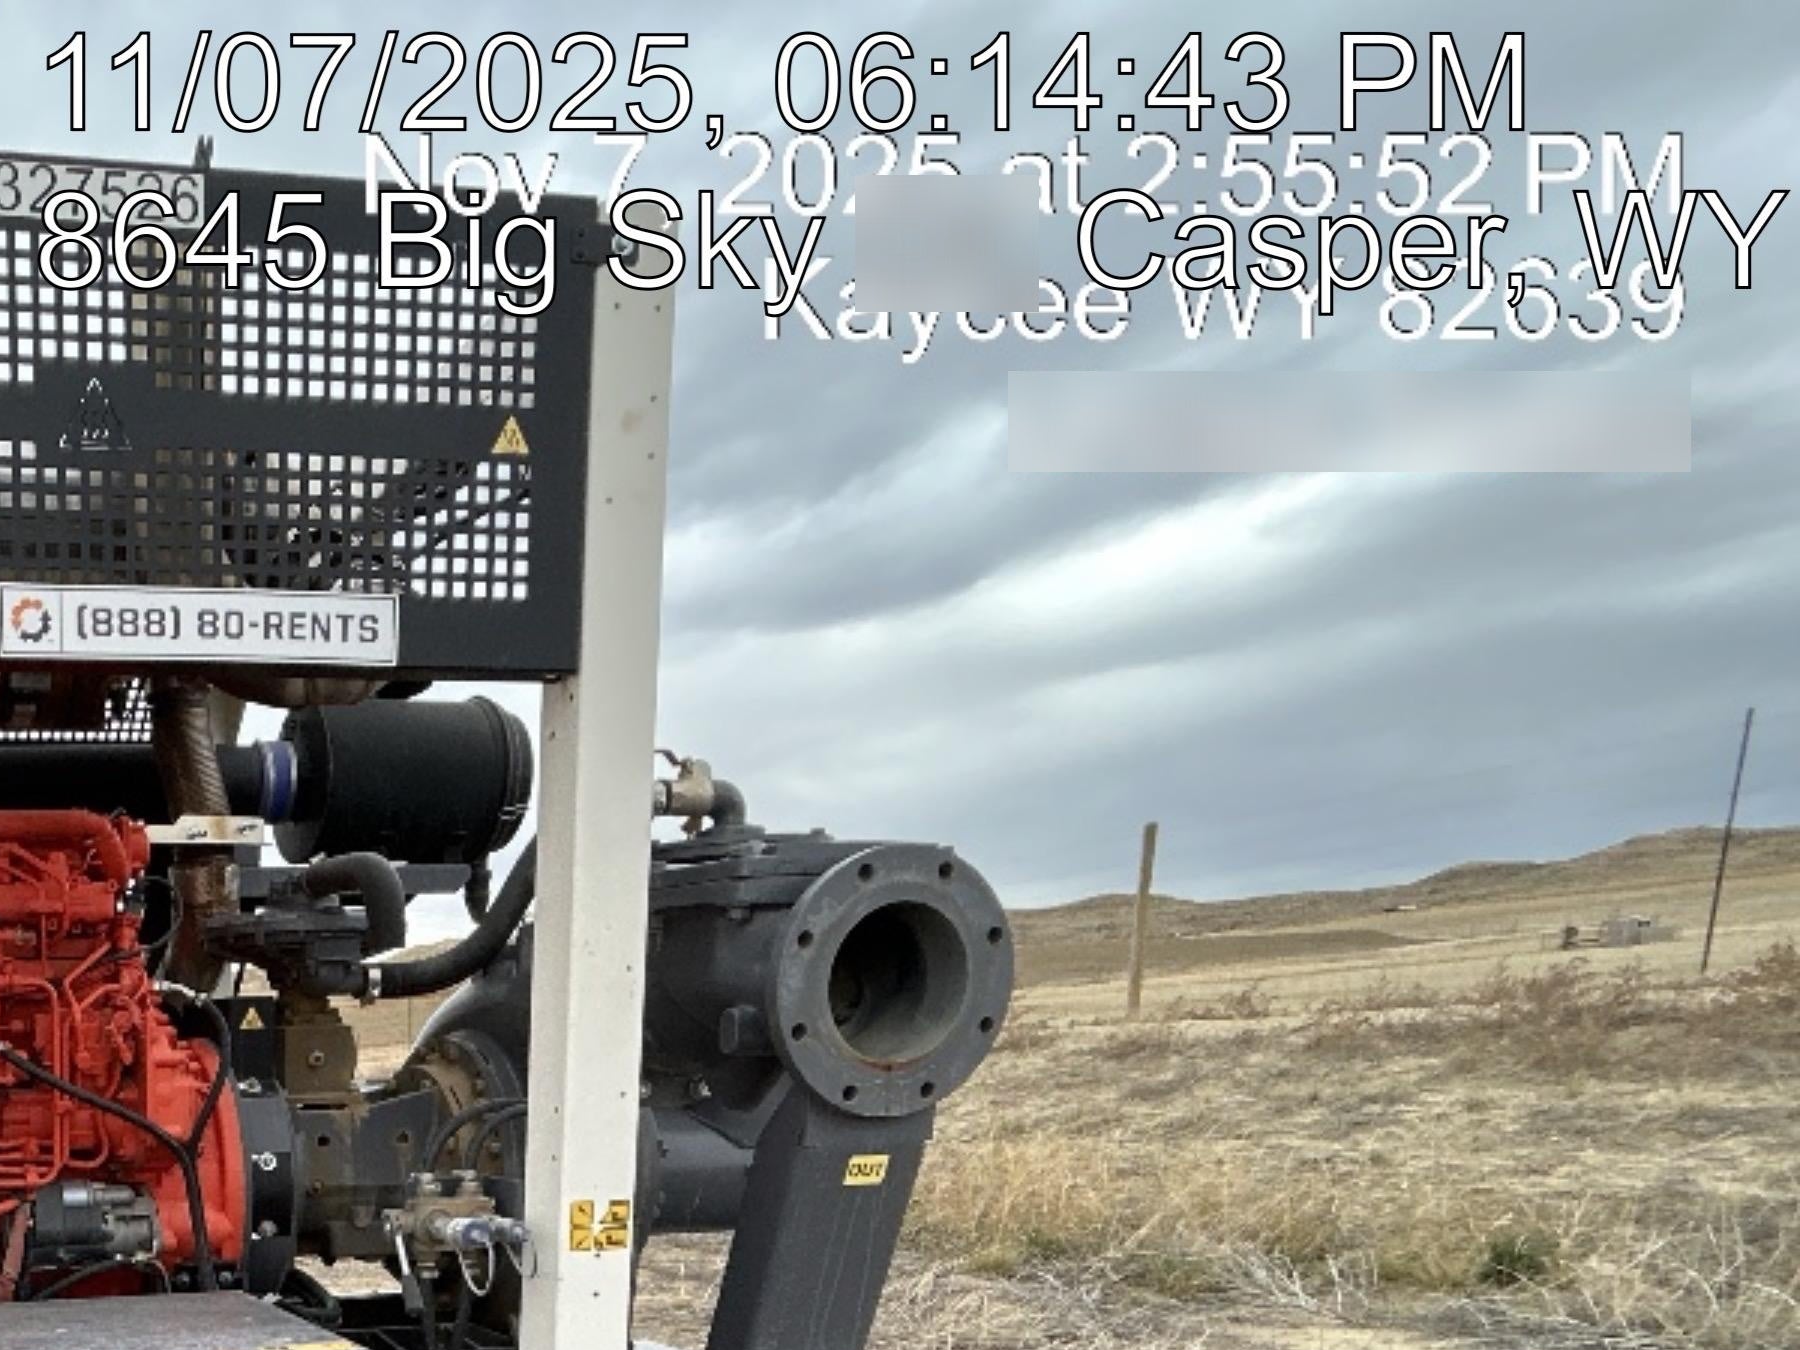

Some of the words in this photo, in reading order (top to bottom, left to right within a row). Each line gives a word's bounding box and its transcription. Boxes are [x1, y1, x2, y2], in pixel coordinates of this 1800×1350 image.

[76, 604, 182, 641] (888)
[197, 609, 380, 645] 80-RENTS
[848, 1162, 884, 1178] OUT
